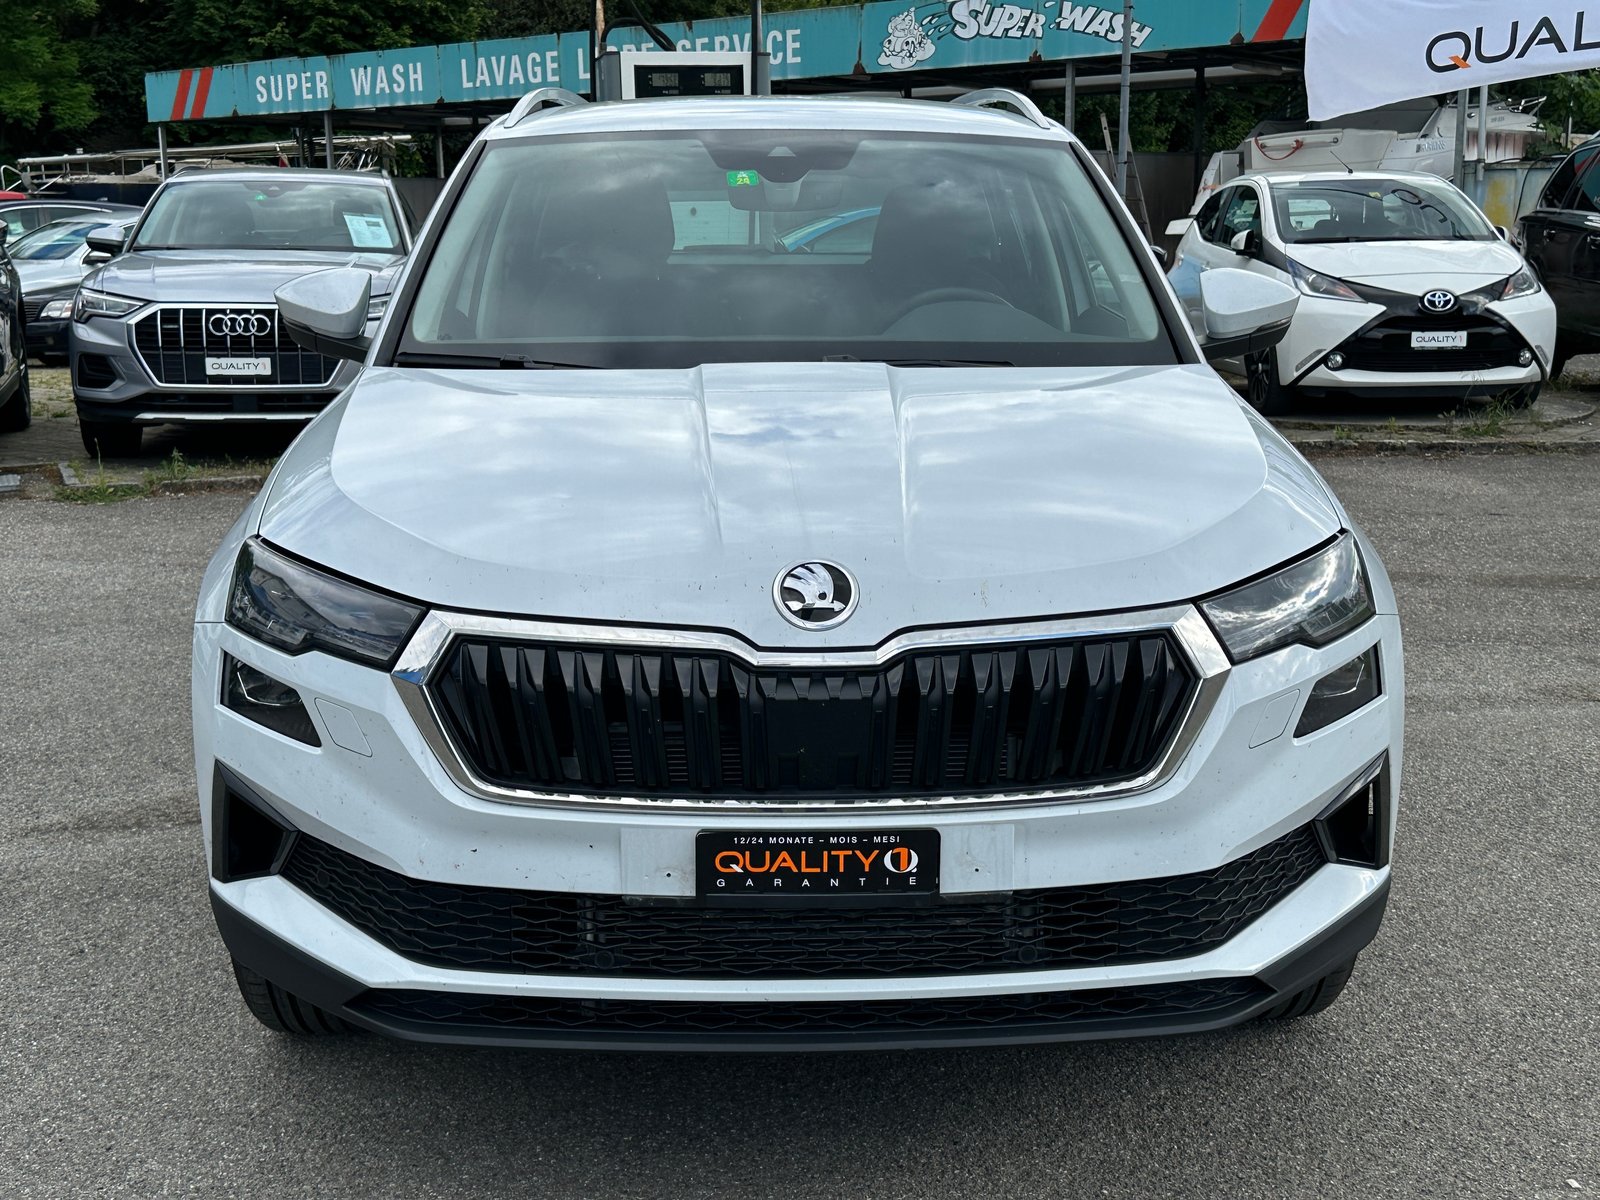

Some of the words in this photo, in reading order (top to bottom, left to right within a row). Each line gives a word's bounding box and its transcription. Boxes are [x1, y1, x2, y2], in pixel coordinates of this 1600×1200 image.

[951, 0, 1046, 39] SUPER
[1059, 1, 1152, 48] WASH
[256, 71, 329, 103] SUPER
[350, 62, 424, 96] WASH
[460, 51, 560, 89] LAVAGE
[1415, 335, 1457, 343] QUALITY
[211, 362, 260, 370] QUALITY
[733, 836, 764, 844] 12/24
[769, 836, 814, 844] MONATE
[830, 836, 858, 844] MOIS
[873, 835, 900, 843] MESI
[714, 850, 880, 873] QUALITY
[716, 876, 917, 888] GARANTIE
